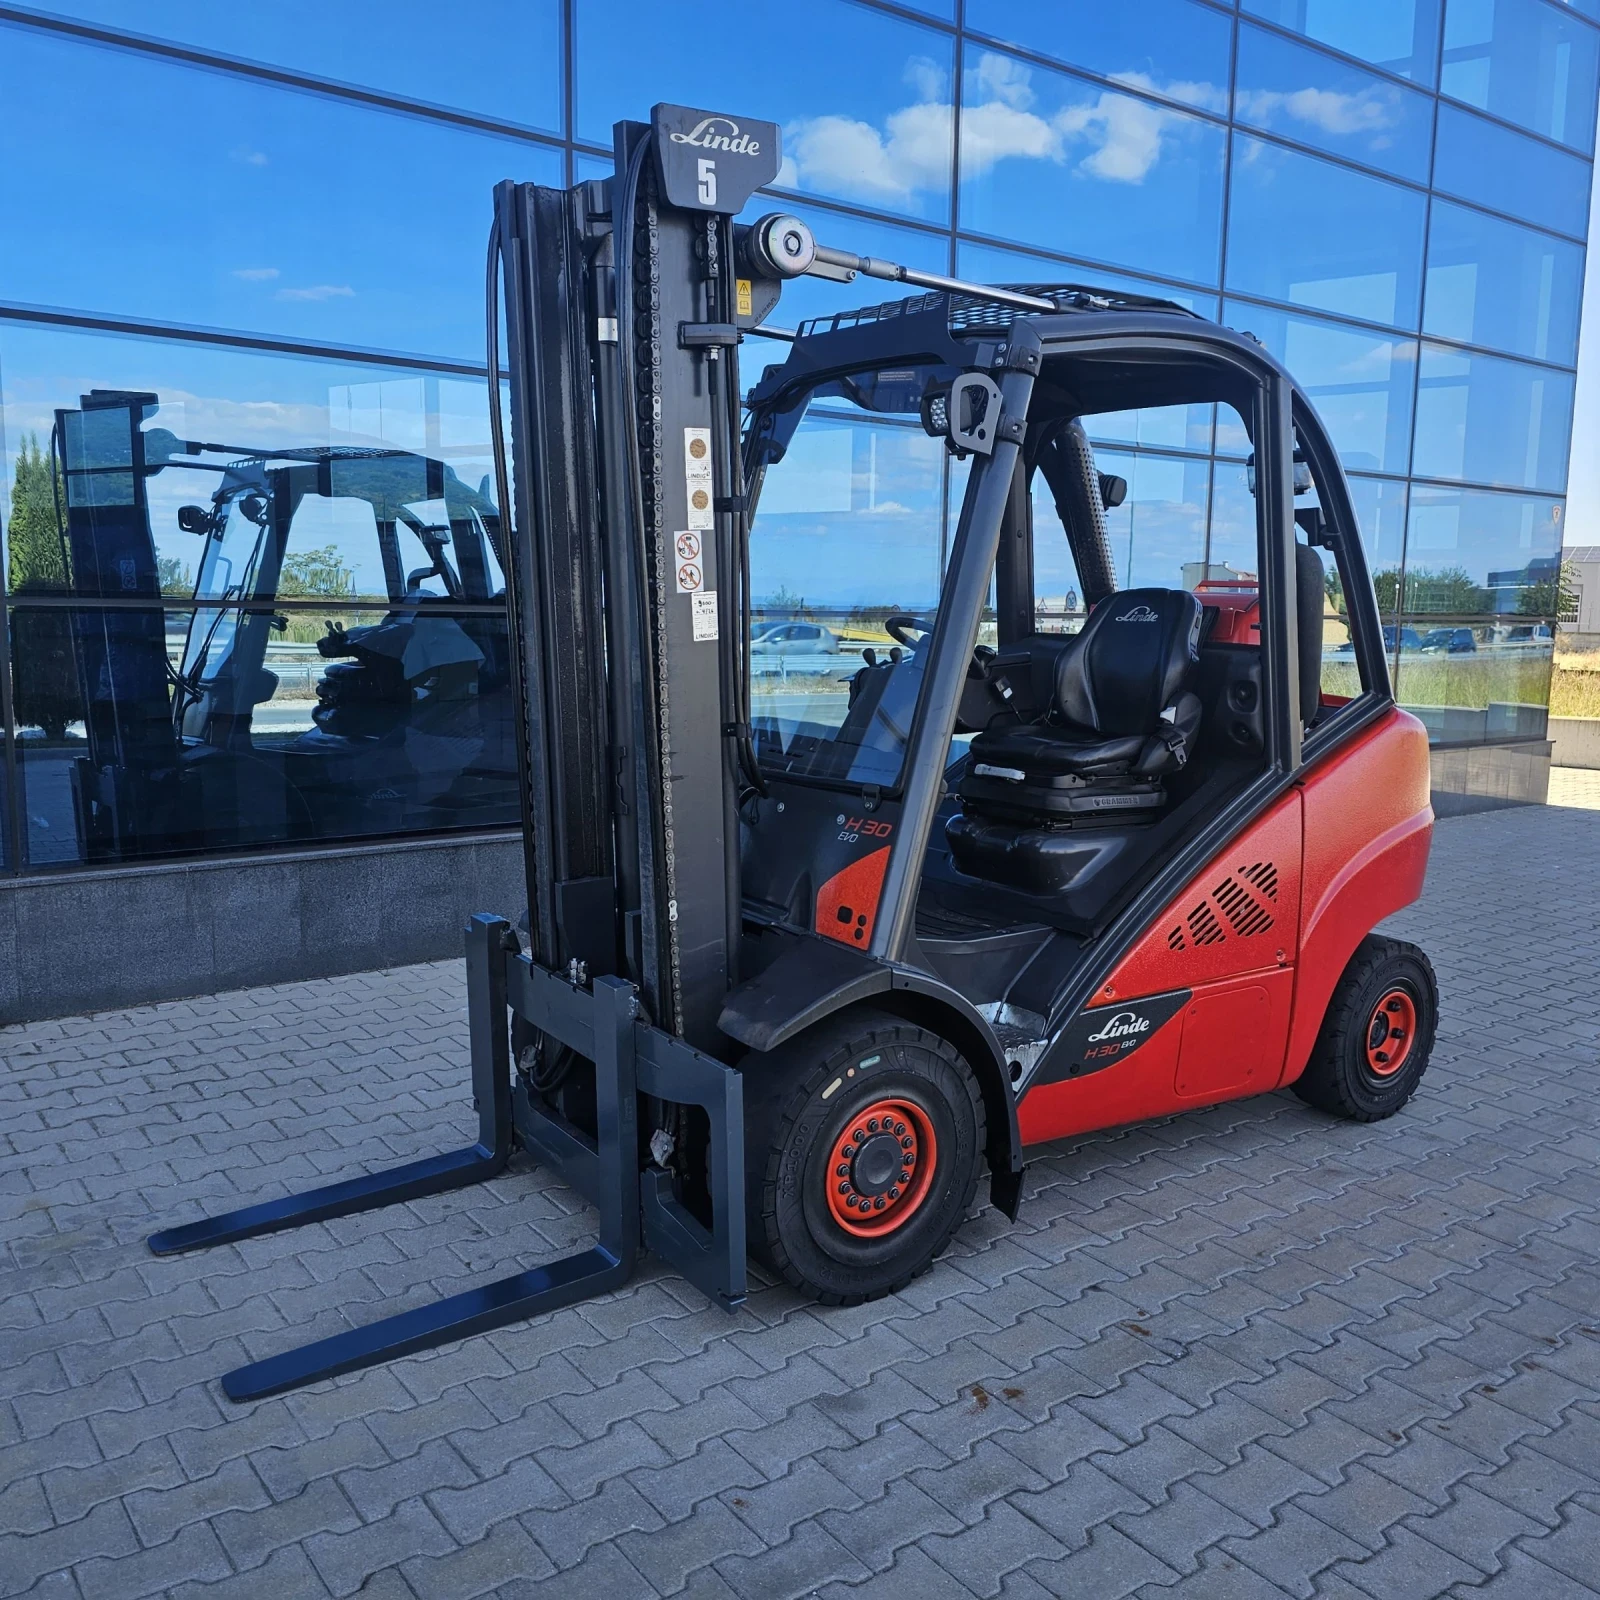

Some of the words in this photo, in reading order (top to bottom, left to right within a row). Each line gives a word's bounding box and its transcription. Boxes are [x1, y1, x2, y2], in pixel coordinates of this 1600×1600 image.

[669, 117, 761, 156] Linde
[697, 158, 717, 206] 5
[1114, 605, 1159, 623] Linde
[837, 831, 859, 843] EVO
[1087, 1012, 1150, 1042] Linde
